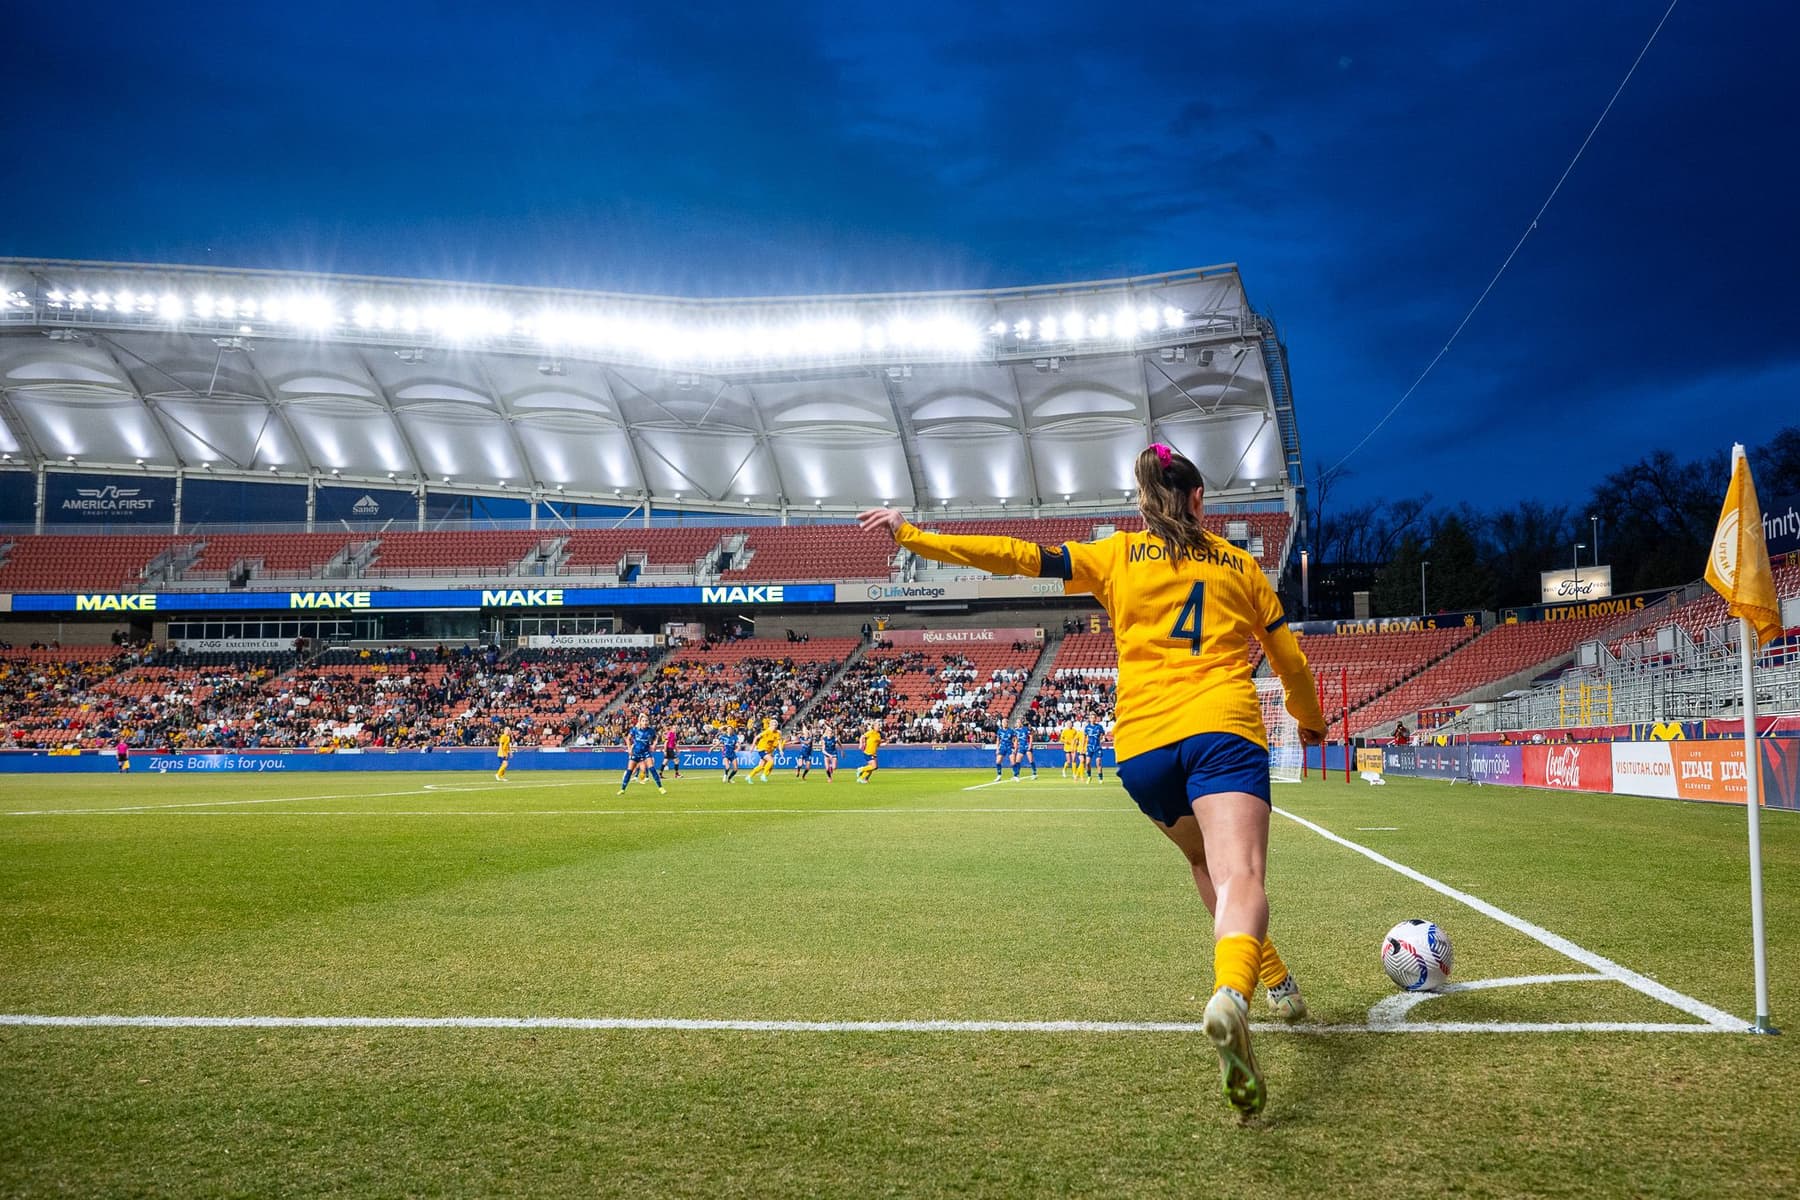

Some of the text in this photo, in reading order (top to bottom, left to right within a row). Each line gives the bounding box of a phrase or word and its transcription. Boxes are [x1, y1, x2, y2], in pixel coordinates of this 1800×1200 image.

[62, 499, 155, 509] AMERICA FIRST
[352, 506, 379, 516] Sandy
[1762, 506, 1800, 541] finity
[1129, 543, 1244, 575] MONAGHAN
[1719, 542, 1731, 570] UTAH
[702, 586, 784, 603] MAKE
[884, 586, 945, 598] LifeVantage
[1031, 580, 1064, 594] aptiv
[1558, 580, 1593, 596] Ford
[76, 594, 156, 610] MAKE
[290, 591, 370, 608] MAKE
[482, 589, 564, 606] MAKE
[1544, 597, 1645, 621] UTAH ROYALS
[1168, 579, 1206, 656] 4
[1090, 618, 1101, 634] 5
[1336, 619, 1437, 635] UTAH ROYALS
[551, 637, 573, 645] ZAGG
[615, 636, 633, 644] CLUB
[923, 629, 994, 642] REAL SALT LAKE
[199, 640, 222, 648] ZAGG
[262, 640, 279, 648] CLUB
[150, 756, 286, 771] Zions Bank is for you.
[683, 754, 719, 766] Zions
[774, 753, 792, 766] for
[795, 756, 823, 768] yu.
[1470, 753, 1489, 779] xfinity
[1489, 753, 1511, 776] mobile
[1616, 761, 1671, 776] VISITUTAH.COM
[1681, 761, 1713, 780] UTAH
[1720, 761, 1748, 781] UTA
[1684, 782, 1711, 790] ELEVATED
